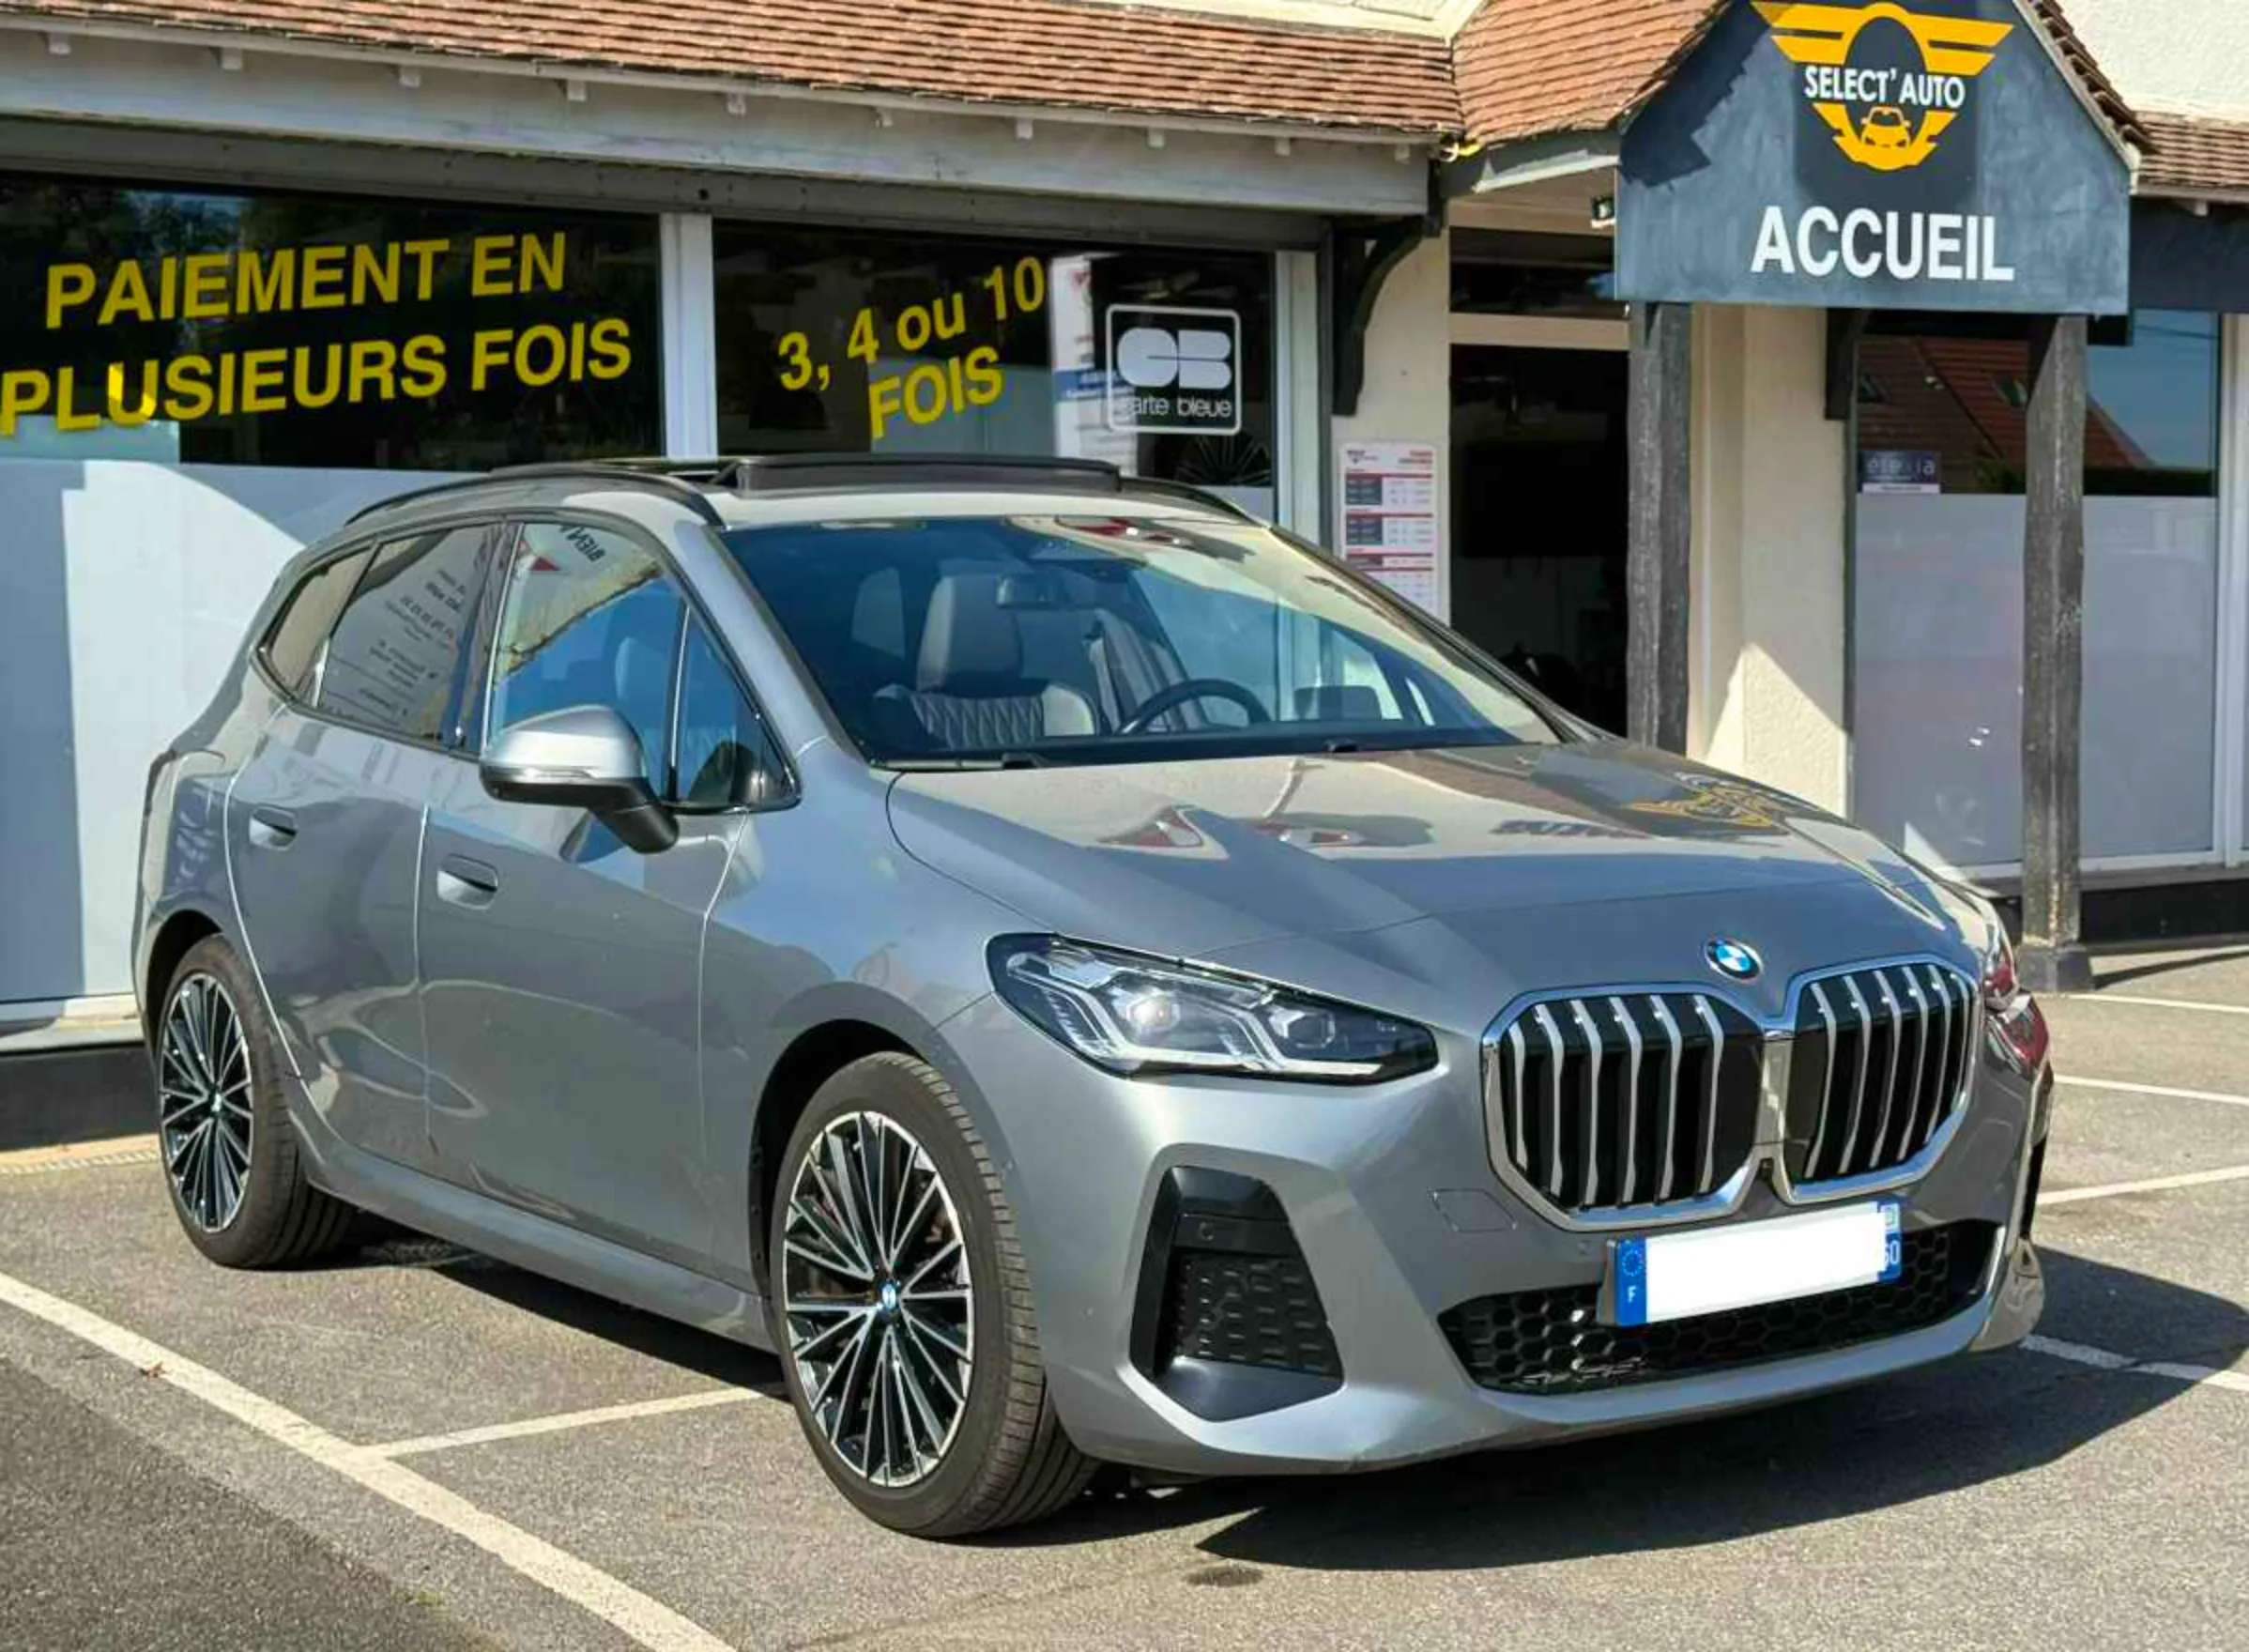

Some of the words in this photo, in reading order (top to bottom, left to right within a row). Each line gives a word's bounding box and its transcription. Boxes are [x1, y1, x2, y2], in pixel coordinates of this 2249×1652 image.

[45, 238, 450, 329] PAIEMENT
[471, 232, 566, 297] EN
[1750, 205, 2016, 283] ACCUEIL
[777, 330, 832, 392] 3,
[846, 308, 880, 363] 4
[895, 292, 966, 352] ou
[983, 256, 1046, 321] 10
[0, 334, 448, 437] PLUSIEURS
[471, 317, 632, 391] FOIS
[867, 344, 1005, 439] FOIS
[1175, 396, 1233, 418] bleue
[1627, 1285, 1637, 1304] F
